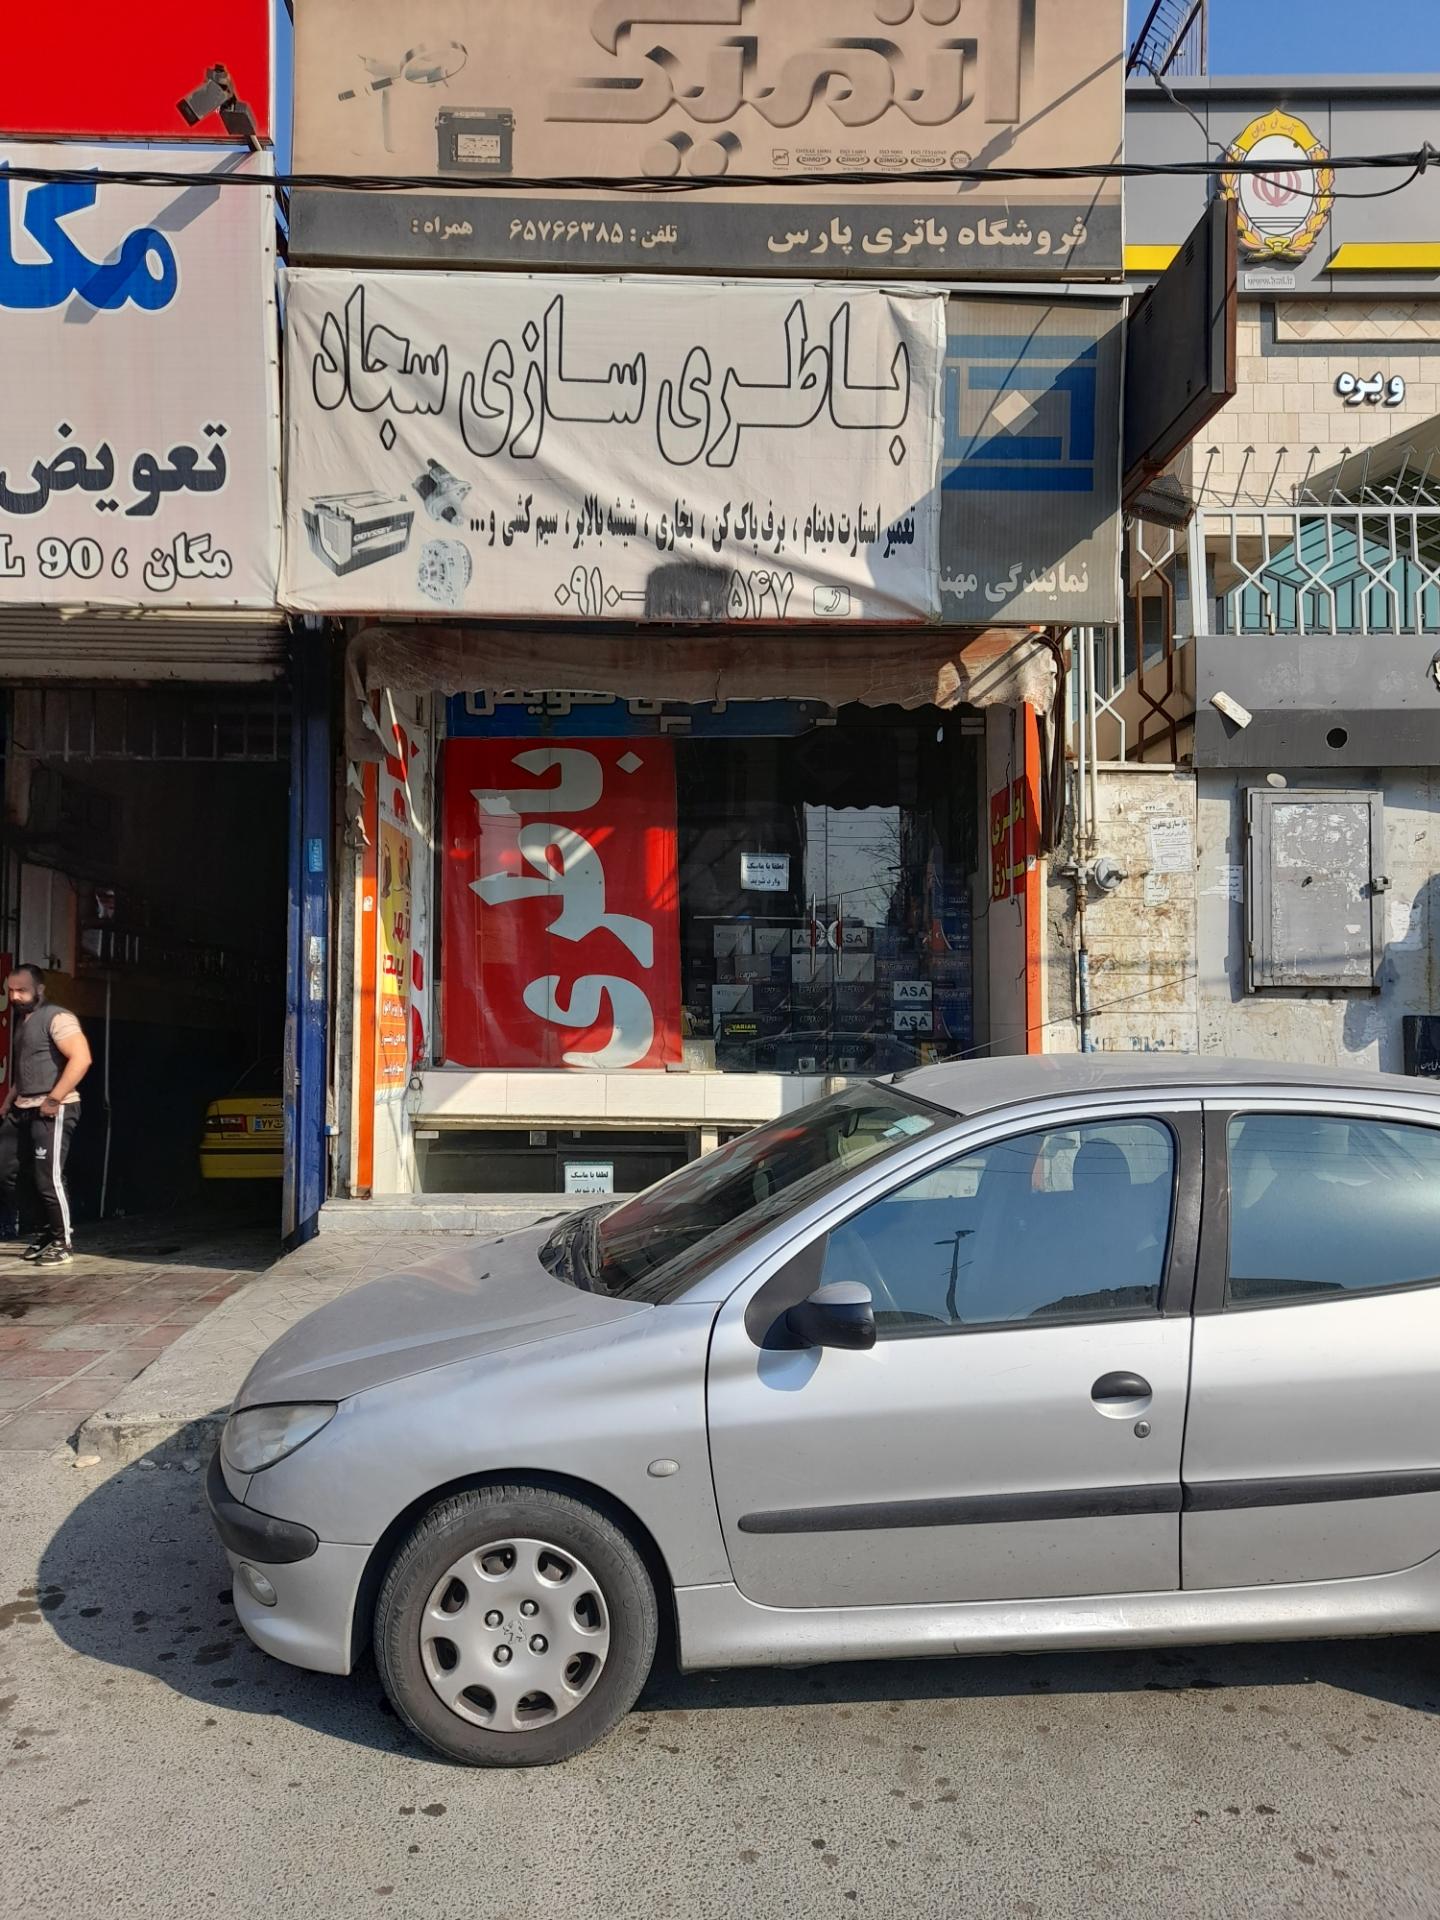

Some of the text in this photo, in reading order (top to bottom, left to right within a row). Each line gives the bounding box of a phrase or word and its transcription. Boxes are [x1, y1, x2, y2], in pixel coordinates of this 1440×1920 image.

[509, 218, 624, 243] ۶۵۷۶۶۳۸۵
[767, 215, 1088, 256] فروشگاه باتری پارس
[312, 284, 911, 467] باطری سازی سجاد
[0, 422, 228, 516] تعویض
[502, 493, 534, 547] کشی
[536, 513, 559, 547] سیم
[572, 492, 604, 549] بالابر
[607, 496, 638, 548] شیشه
[656, 498, 694, 551] بخاری
[761, 499, 786, 554] برف
[804, 502, 835, 555] دینام
[838, 501, 882, 558] استارت
[883, 504, 916, 559] تعمیر
[37, 537, 103, 579] 90
[144, 531, 233, 592] مگان
[938, 561, 1089, 603] نمایندگی مهن
[468, 747, 655, 1068] باطری
[899, 986, 928, 997] ASA
[899, 1016, 928, 1027] ASA
